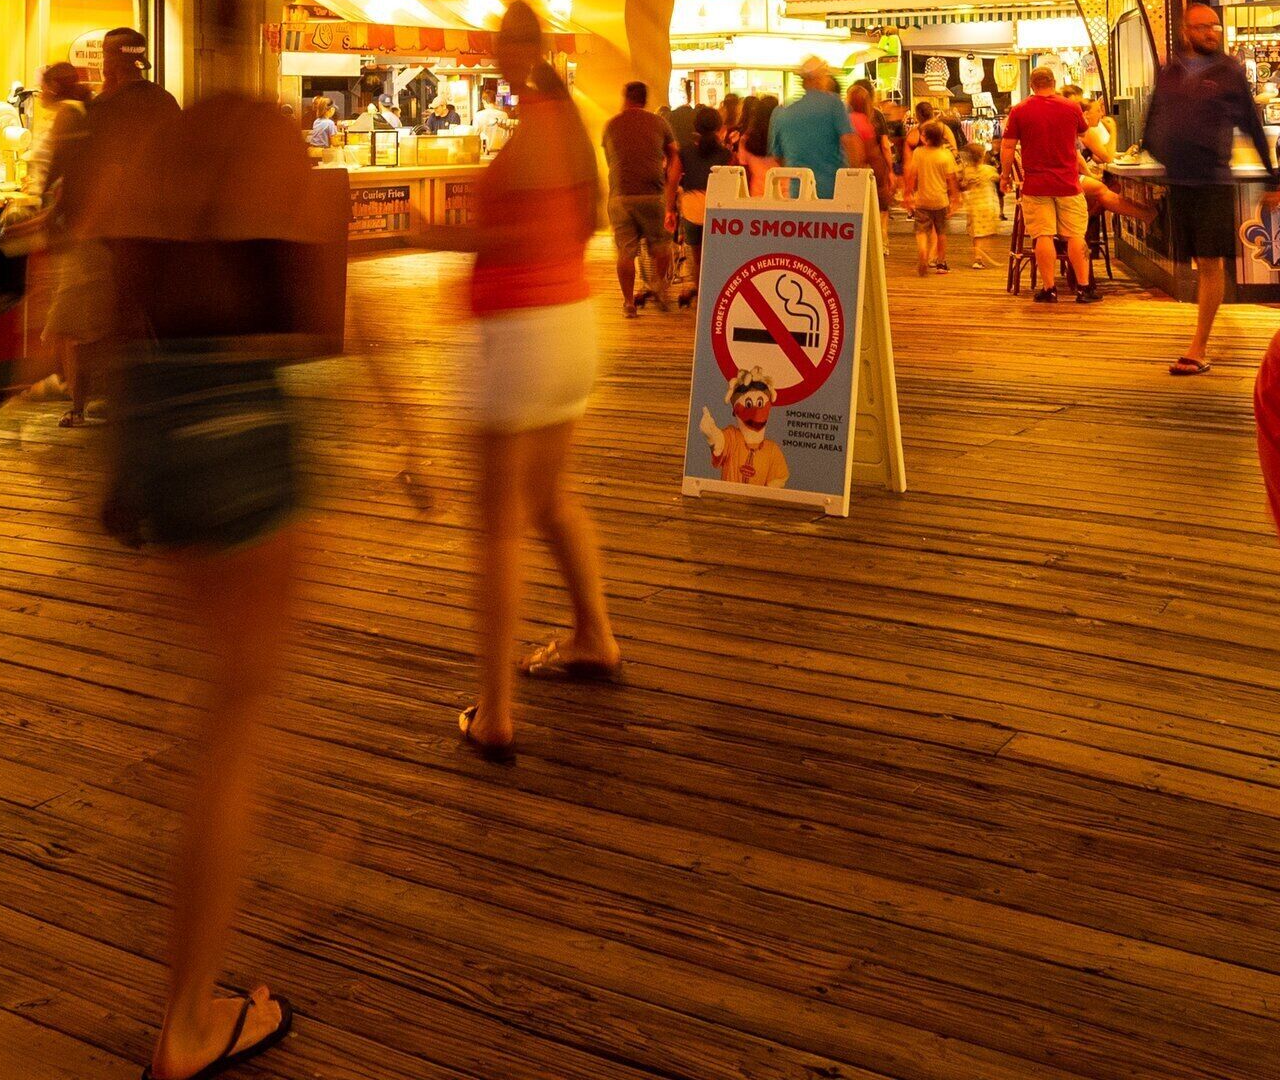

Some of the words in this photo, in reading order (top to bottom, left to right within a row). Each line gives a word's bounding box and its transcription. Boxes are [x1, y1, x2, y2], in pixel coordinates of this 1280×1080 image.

[362, 190, 386, 200] Curley
[387, 189, 405, 198] Fries
[711, 218, 744, 236] NO
[750, 219, 855, 241] SMOKING
[715, 297, 729, 335] MOREY'S
[725, 275, 742, 297] PIERS
[741, 269, 750, 279] IS
[750, 264, 756, 273] A
[757, 257, 791, 270] HEALTHY,
[792, 260, 832, 297] SMOKE-FREE
[825, 297, 840, 364] ENVIRONMENT!
[786, 410, 821, 420] SMOKING
[822, 413, 843, 422] ONLY
[786, 420, 829, 431] PERMITTED
[788, 430, 835, 441] DESIGNATED
[782, 439, 817, 450] SMOKING
[818, 443, 843, 452] AREAS
